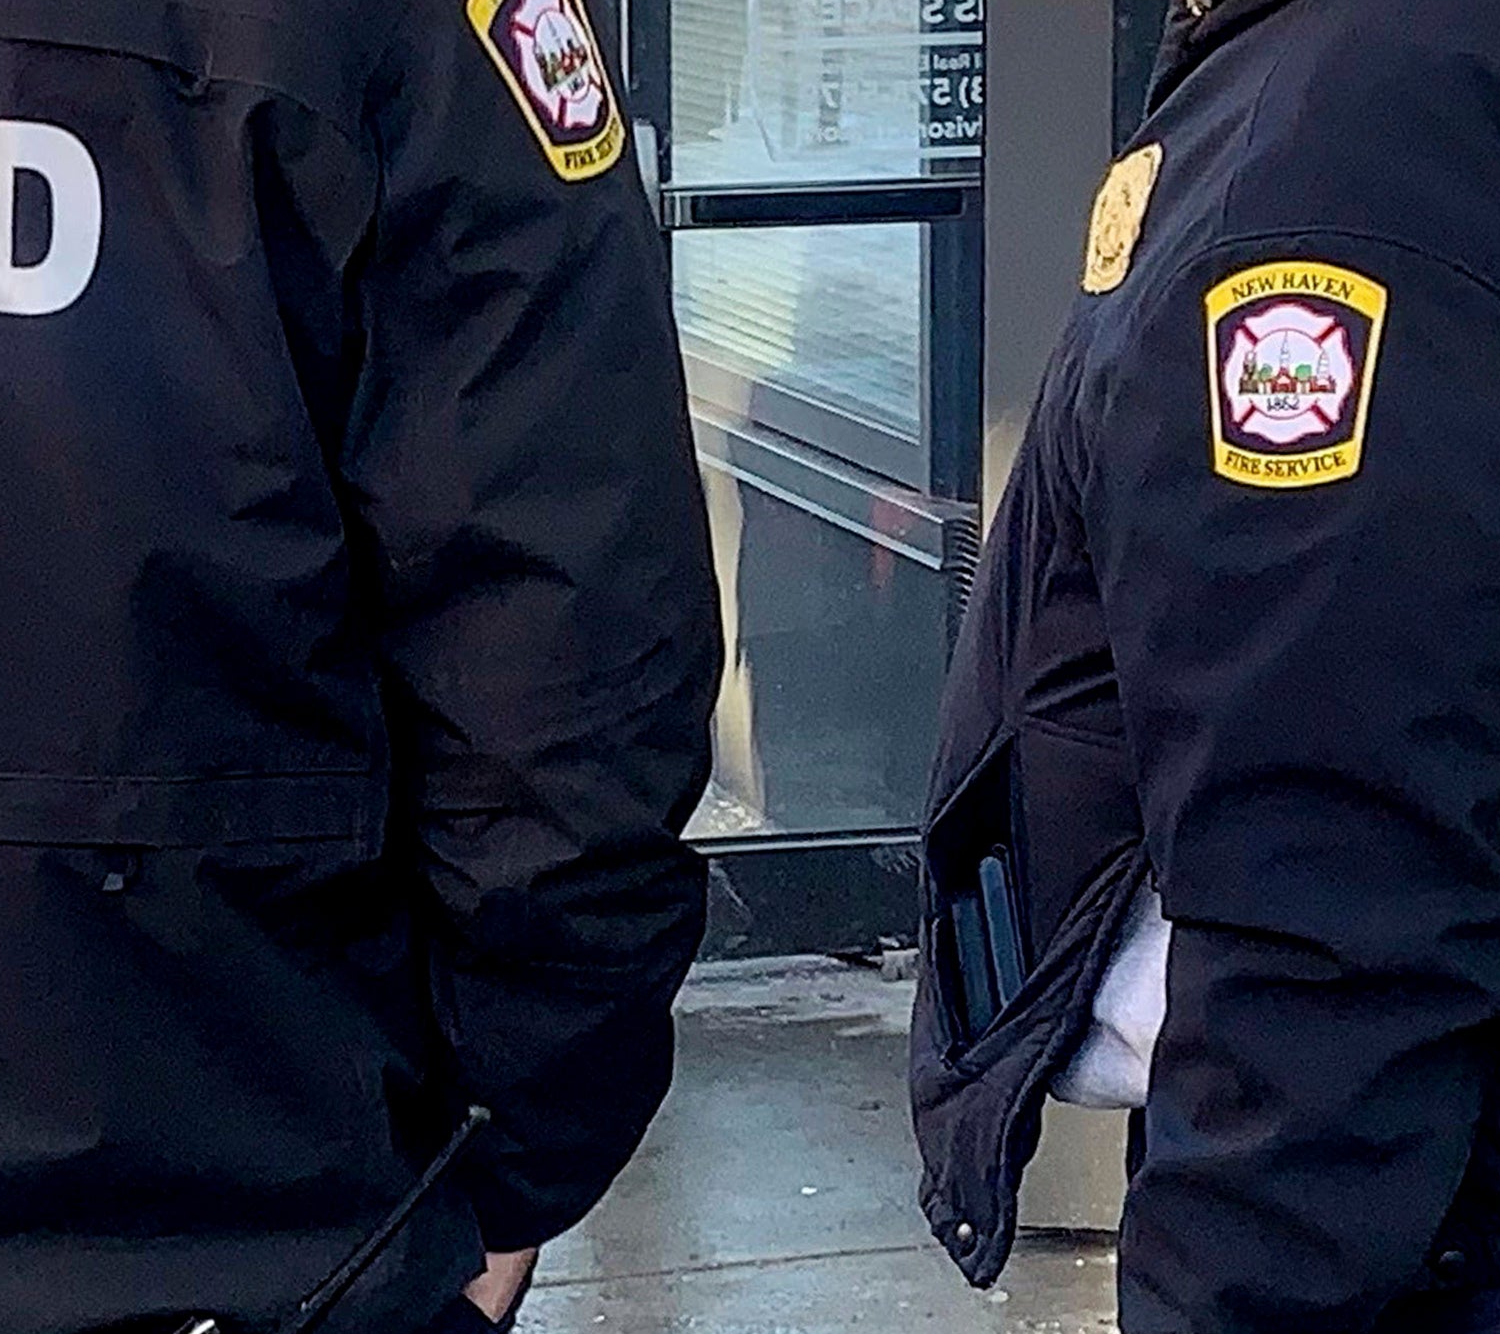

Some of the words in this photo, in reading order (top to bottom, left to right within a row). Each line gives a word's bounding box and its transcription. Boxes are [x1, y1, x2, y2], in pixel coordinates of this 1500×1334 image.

[1232, 273, 1276, 301] NEW
[1282, 273, 1355, 301] HAVEN
[1224, 451, 1260, 476] FIRE
[1265, 451, 1346, 476] SERVICE
